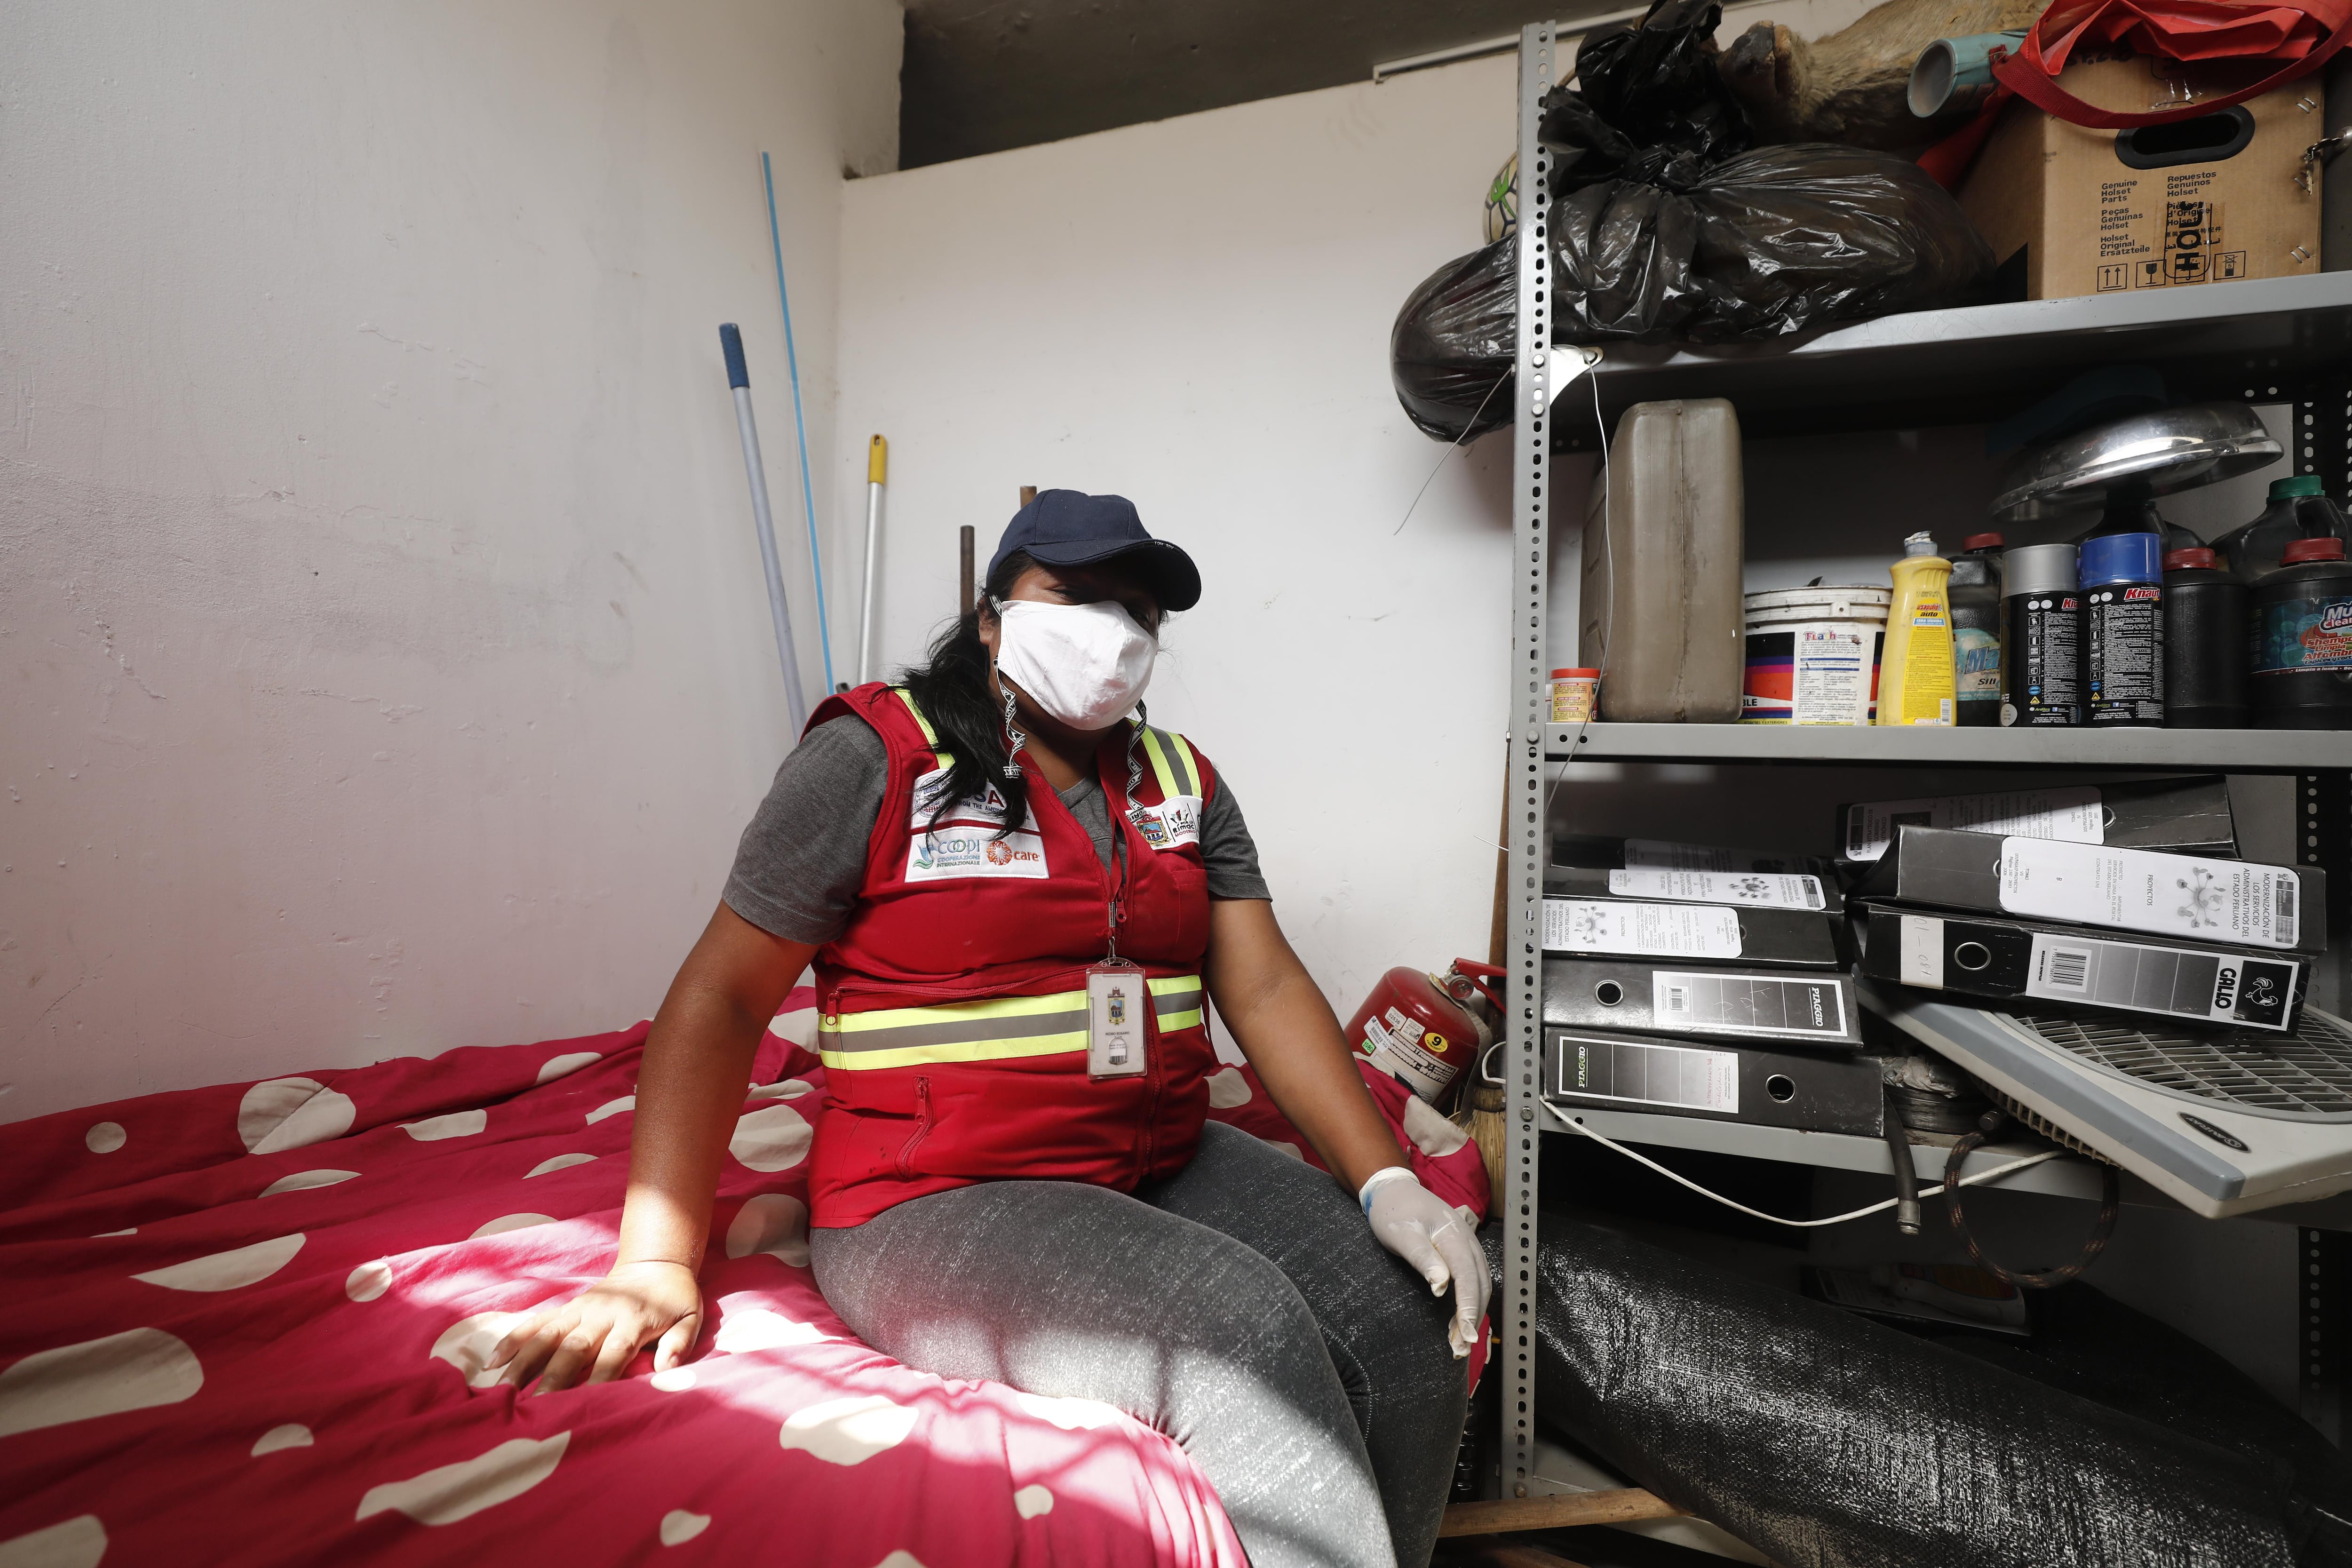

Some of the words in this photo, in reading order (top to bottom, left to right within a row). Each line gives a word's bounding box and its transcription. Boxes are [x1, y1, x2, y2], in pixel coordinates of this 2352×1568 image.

[2168, 171, 2217, 183] Repuestos
[2102, 180, 2137, 190] Genuine
[2167, 179, 2210, 190] Genuinos
[2101, 187, 2131, 197] Holset
[2167, 188, 2198, 197] Holset
[2102, 195, 2127, 204] Parts
[2101, 207, 2130, 216] Peças
[2101, 213, 2143, 223] Genuínas
[2167, 217, 2198, 226] Holset
[2100, 221, 2129, 231] Holset
[2100, 233, 2129, 243] Holset
[2100, 239, 2135, 250] Original
[2100, 245, 2150, 257] Ersatzteile
[2315, 644, 2346, 652] Limpia
[1172, 823, 1195, 834] Rímac
[1013, 851, 1039, 862] care
[2263, 873, 2272, 928] MODERNIZACIÓN
[2263, 930, 2269, 939] DE
[2215, 968, 2237, 1009] GALLO
[1811, 986, 1824, 1027] PIAGGIO
[1431, 1036, 1442, 1046] 9
[1363, 1041, 1374, 1052] 1080
[1578, 1047, 1587, 1088] PIAGGIO
